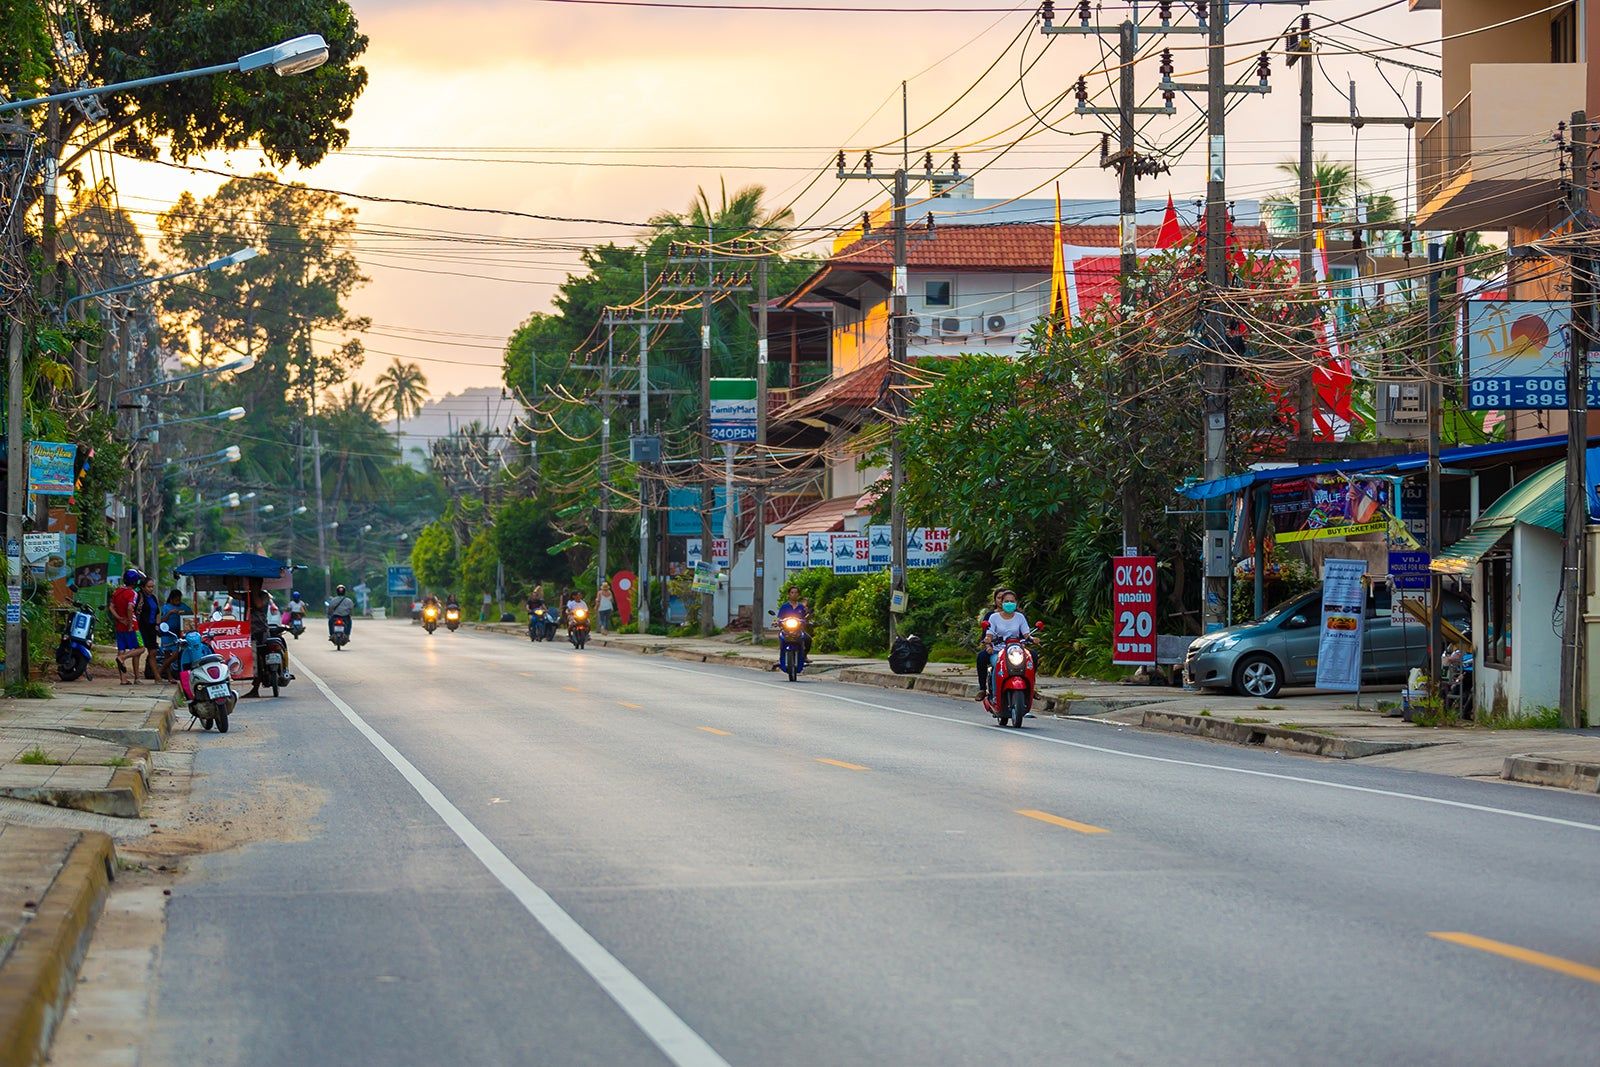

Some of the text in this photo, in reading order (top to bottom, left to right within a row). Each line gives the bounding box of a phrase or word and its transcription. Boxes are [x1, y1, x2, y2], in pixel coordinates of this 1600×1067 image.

[711, 405, 756, 415] FamilyMart
[1344, 525, 1369, 533] TICKET
[1371, 522, 1387, 530] HERE
[925, 530, 949, 540] REN
[856, 540, 869, 549] RE
[856, 551, 869, 560] SA
[1116, 565, 1153, 586] OK 20
[1118, 590, 1151, 605] ทุกอย่าง
[1119, 611, 1152, 637] 20
[1117, 643, 1151, 653] บาท
